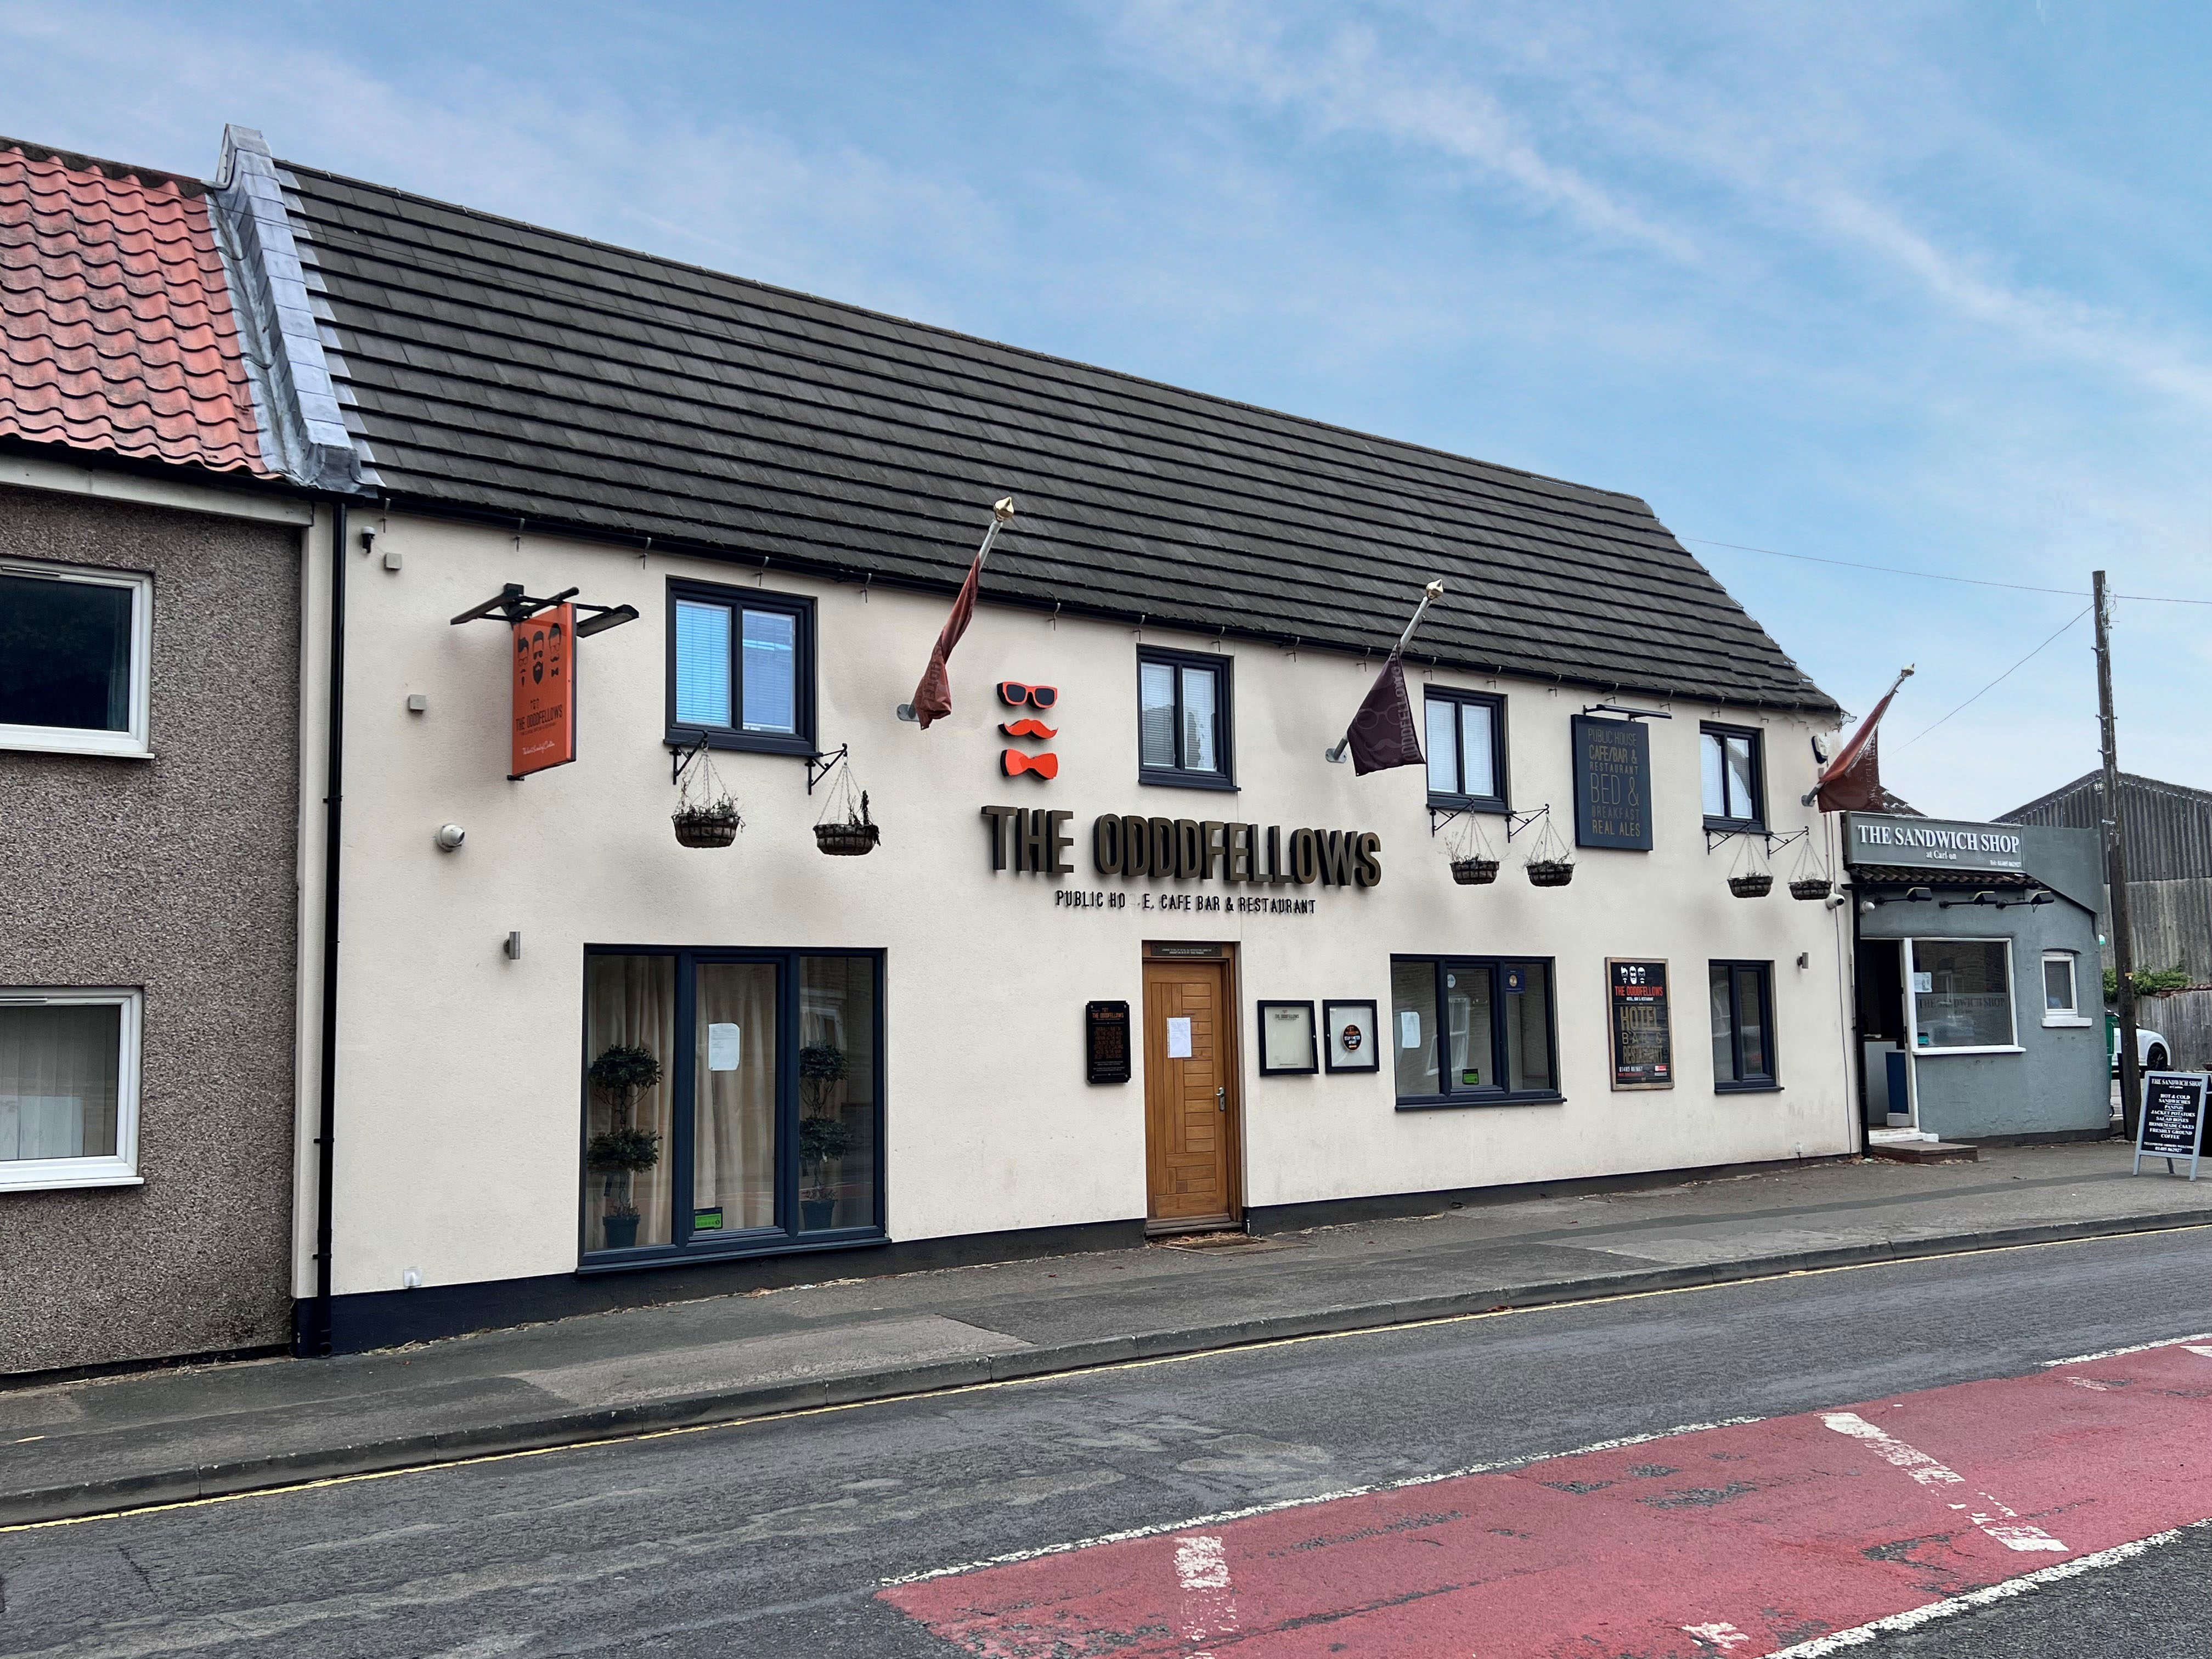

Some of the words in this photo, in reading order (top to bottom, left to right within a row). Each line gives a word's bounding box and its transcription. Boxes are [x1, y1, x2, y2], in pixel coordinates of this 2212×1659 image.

[516, 716, 525, 732] THE
[1588, 728, 1612, 743] PUBLIC
[1615, 732, 1637, 747] HOUSE
[1589, 744, 1628, 764] CAFE/BAR
[1631, 749, 1638, 764] &
[1589, 761, 1638, 775] RESTAURANT
[1590, 772, 1621, 805] BED
[1628, 776, 1639, 806] &
[1592, 805, 1640, 821] BREAKFAST
[1592, 820, 1615, 835] REAL
[1619, 822, 1640, 837] ALES
[981, 805, 1074, 873] THE
[1093, 814, 1381, 887] ODDDFELLOWS
[1858, 825, 1892, 844] THE
[1895, 828, 1978, 851] SANDWICH
[1981, 834, 2019, 853] SHOP
[1926, 850, 1933, 859] at
[1933, 850, 1957, 860] Carlon
[1056, 890, 1103, 907] PUBLIC
[1160, 894, 1191, 910] CAFE
[1197, 895, 1220, 911] BAR
[1226, 896, 1234, 911] &
[1239, 897, 1316, 914] RESTAURANT
[1615, 986, 1626, 996] THE
[1918, 998, 1936, 1008] THE
[1984, 997, 2005, 1007] SHOP
[1620, 1006, 1662, 1031] HOTEL
